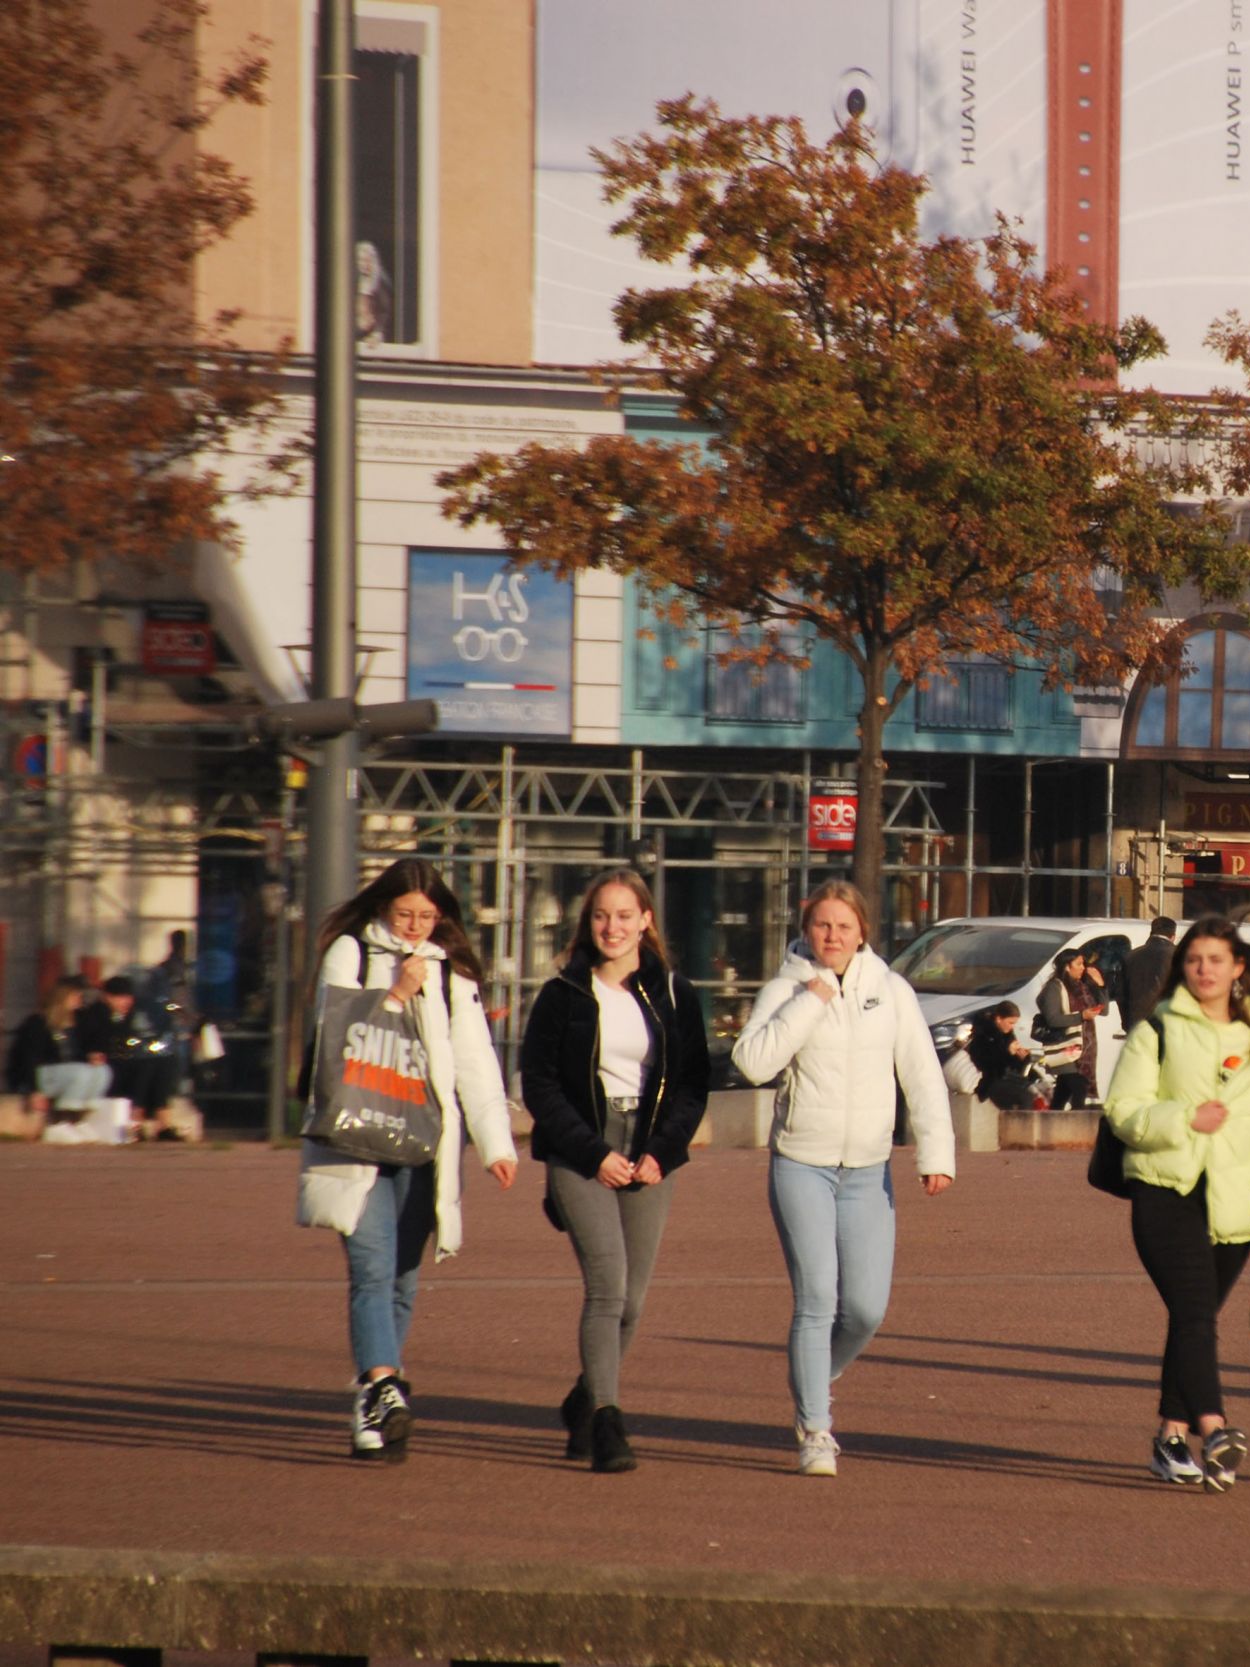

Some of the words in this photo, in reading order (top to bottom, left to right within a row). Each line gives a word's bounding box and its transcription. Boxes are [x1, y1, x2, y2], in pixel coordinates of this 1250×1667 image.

[1227, 41, 1242, 56] P
[961, 51, 976, 165] HUAWEI
[1226, 67, 1241, 180] HUAWEI
[1118, 862, 1127, 876] 8
